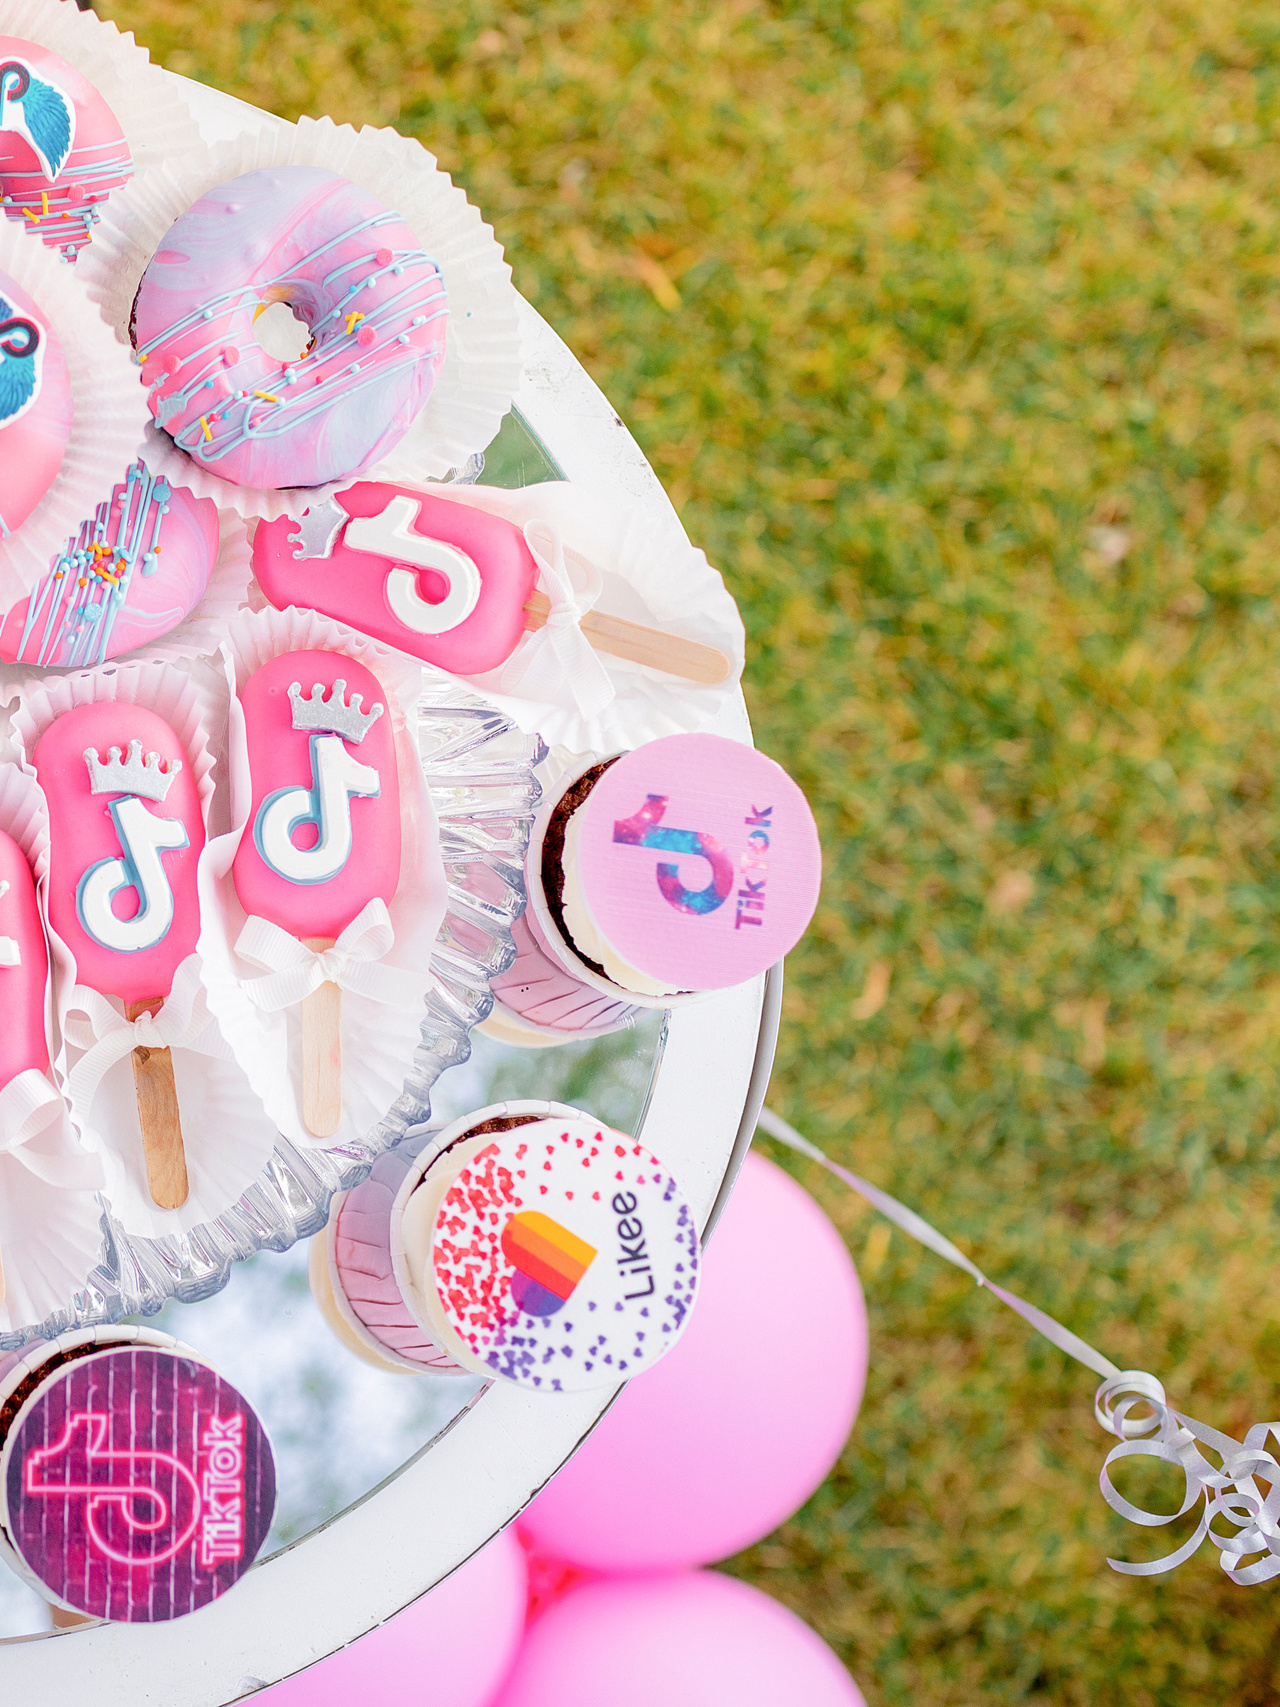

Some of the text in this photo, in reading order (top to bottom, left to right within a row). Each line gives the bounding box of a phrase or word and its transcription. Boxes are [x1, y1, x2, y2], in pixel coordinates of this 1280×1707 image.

[734, 804, 773, 930] TikTok
[611, 1190, 655, 1300] Likee
[201, 1413, 244, 1566] TikTok
